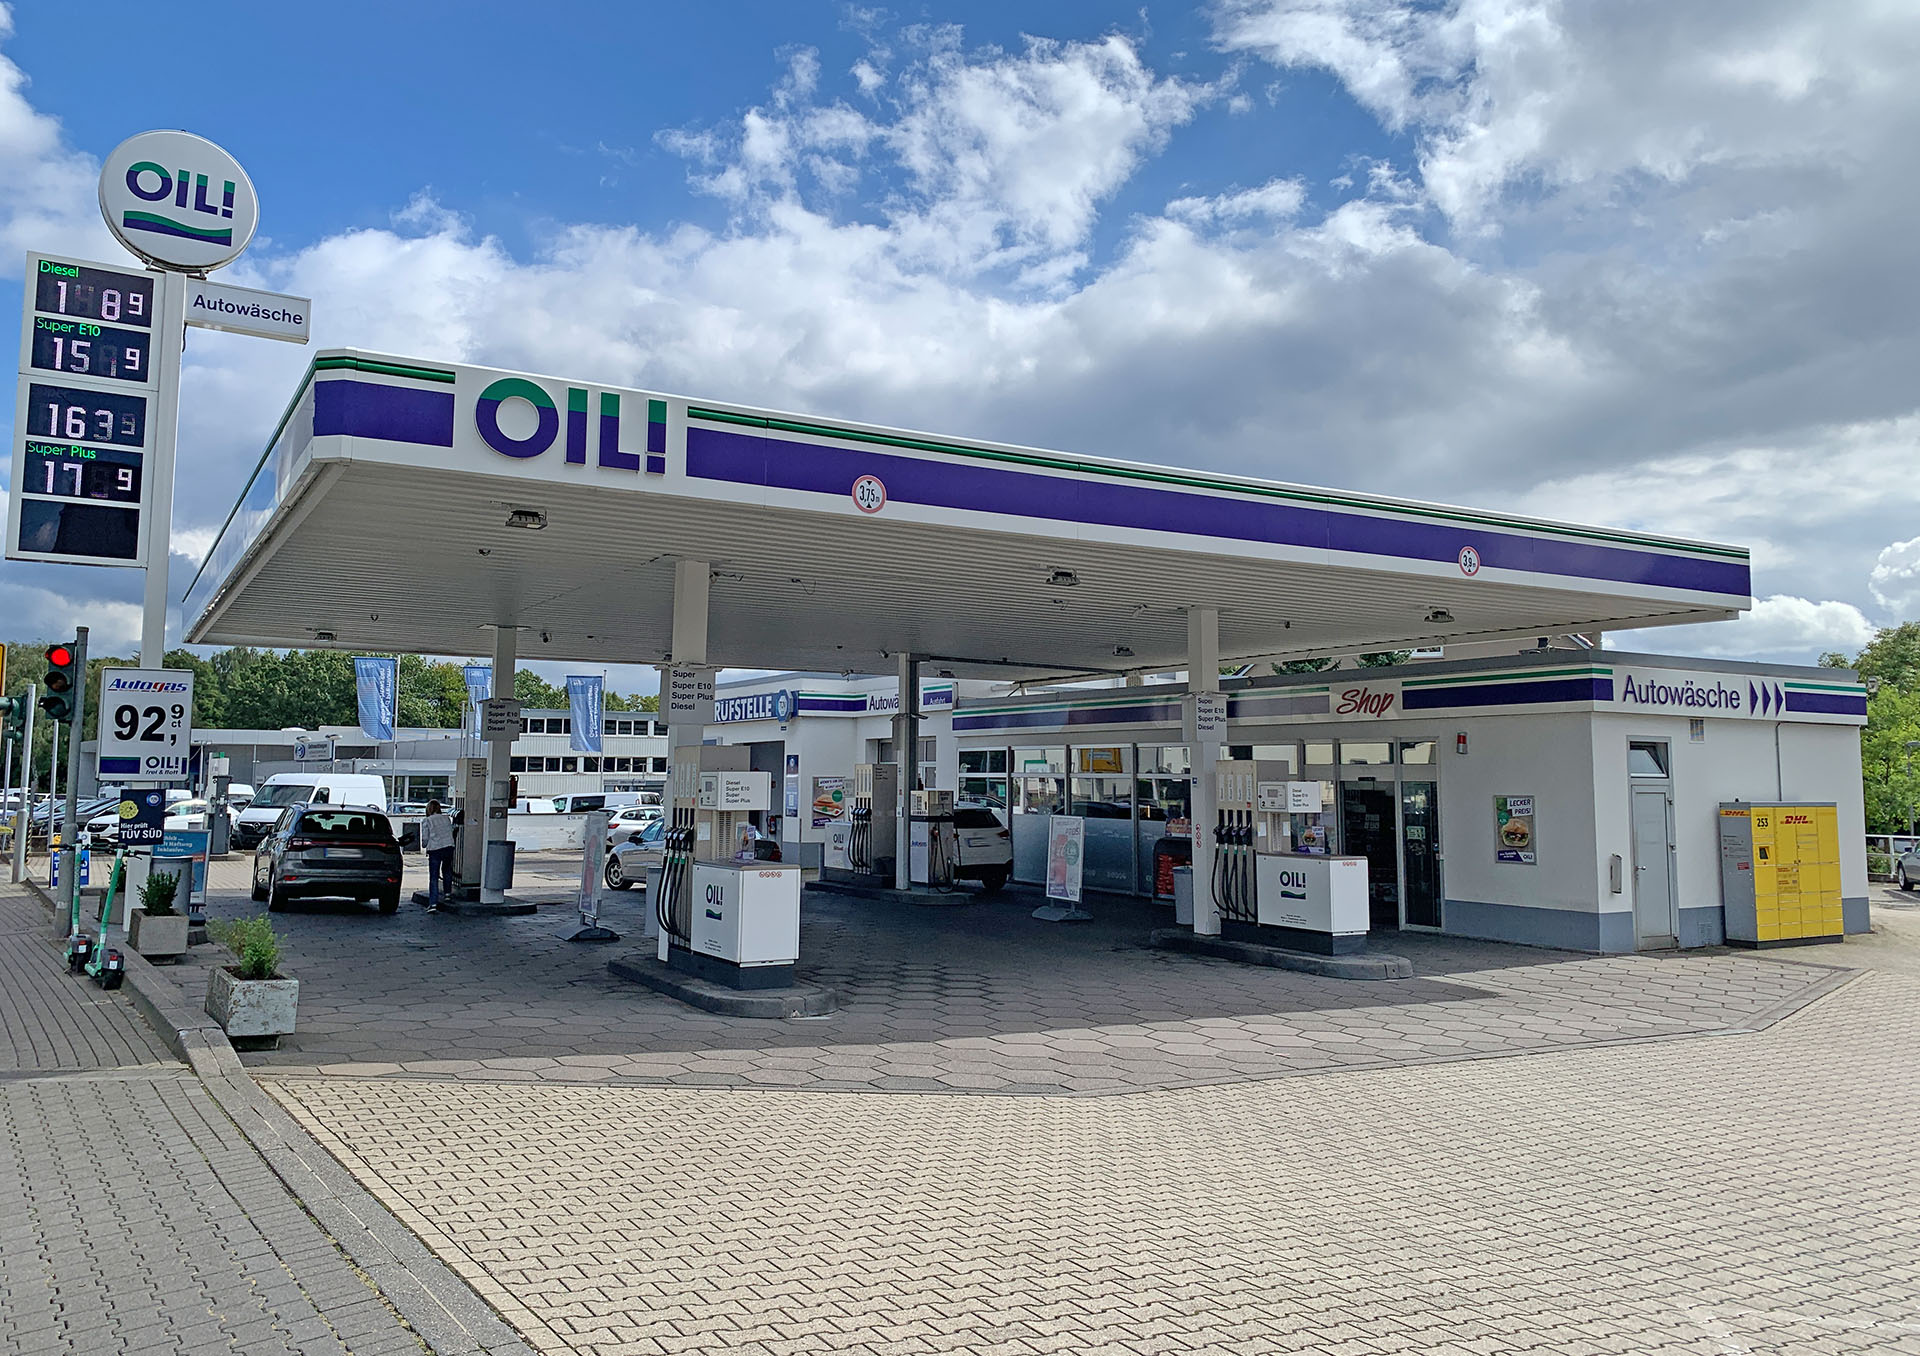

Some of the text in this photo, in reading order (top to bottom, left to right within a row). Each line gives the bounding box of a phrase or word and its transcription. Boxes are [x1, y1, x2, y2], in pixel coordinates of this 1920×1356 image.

[125, 160, 235, 219] OIL!
[40, 260, 79, 278] Diesel
[193, 294, 303, 325] Autowäsche
[36, 317, 101, 337] Super E10
[475, 377, 667, 475] OIL!
[28, 441, 97, 460] Super Plus
[859, 485, 876, 503] 3,75
[672, 669, 696, 679] Super
[109, 678, 189, 692] Autogas
[671, 680, 712, 690] Super E10
[1623, 673, 1741, 710] Autowäsche
[671, 691, 714, 701] Super Plus
[869, 693, 899, 711] Autowä
[1197, 697, 1213, 705] Super
[1336, 687, 1395, 718] Shop
[671, 702, 696, 711] Diesel
[714, 695, 773, 722] RÜFSTELLE
[1197, 706, 1213, 714] Super
[1197, 715, 1213, 723] Super
[145, 755, 180, 769] OIL!
[1509, 799, 1531, 807] LECKER
[1757, 818, 1768, 827] 253
[1784, 815, 1809, 825] DHL
[120, 829, 141, 839] TÜV
[142, 828, 163, 839] SÜD
[1280, 871, 1306, 888] OIL!
[705, 884, 723, 906] OIL!
